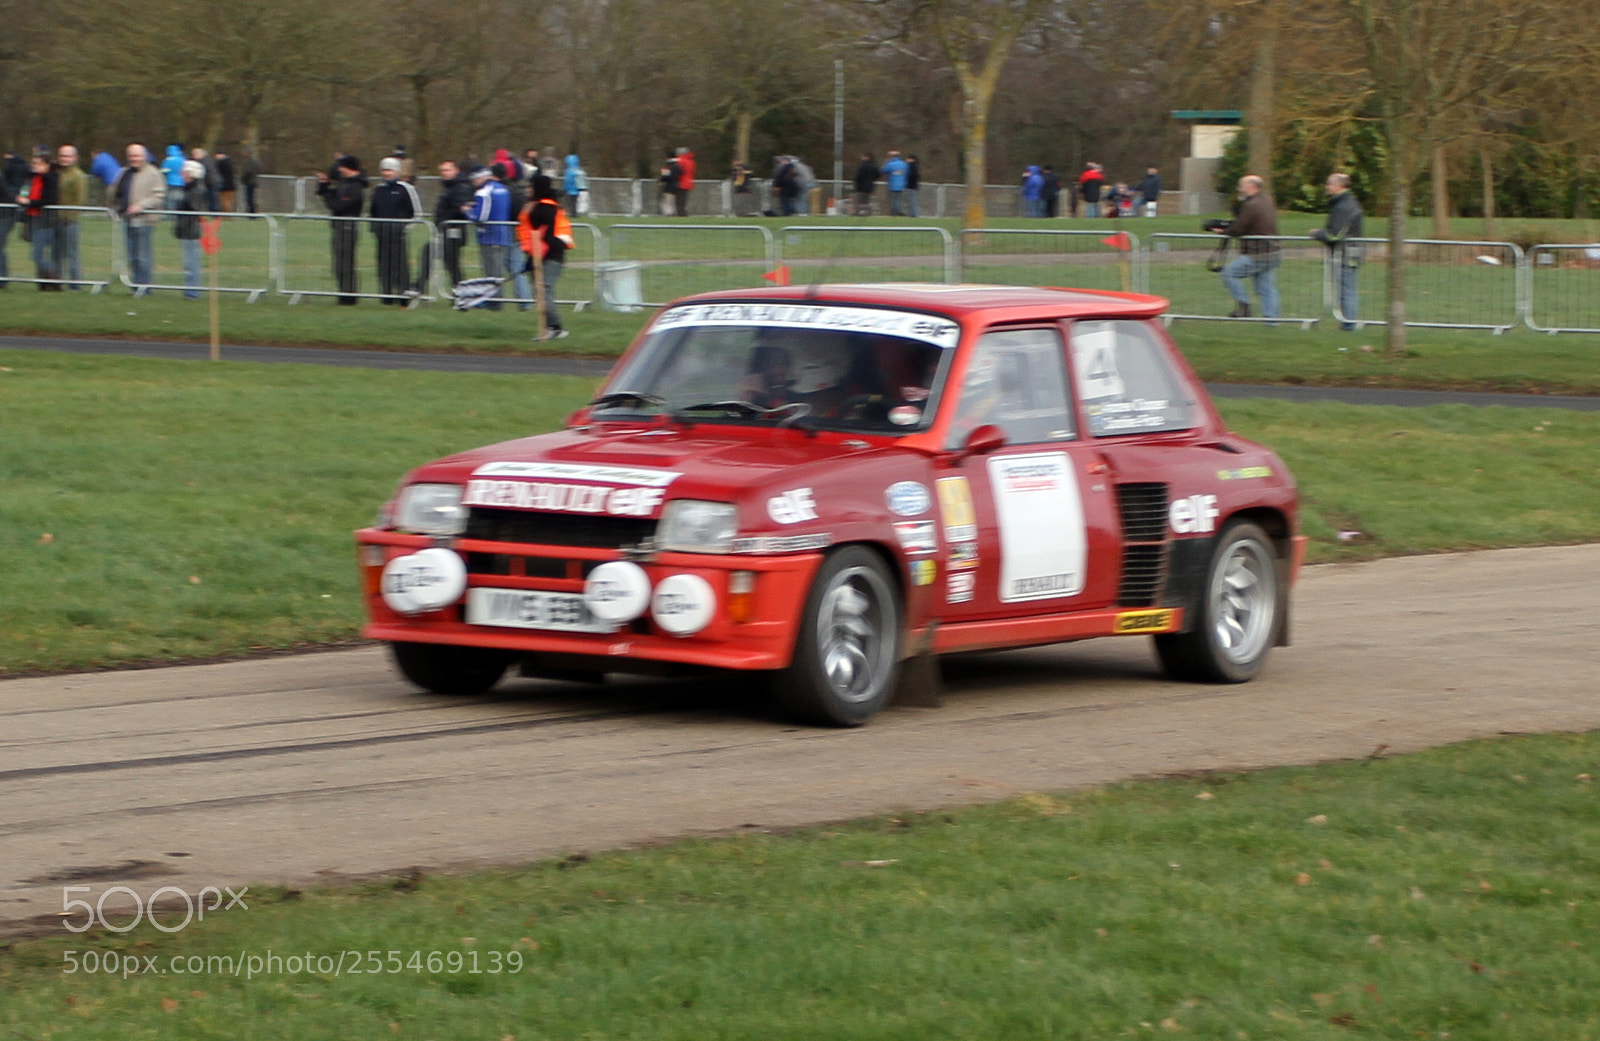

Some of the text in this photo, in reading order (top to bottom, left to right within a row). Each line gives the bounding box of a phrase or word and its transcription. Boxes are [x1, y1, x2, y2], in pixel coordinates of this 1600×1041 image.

[462, 479, 666, 516] RENAULT elf
[766, 487, 819, 525] elf
[1169, 494, 1219, 534] elf
